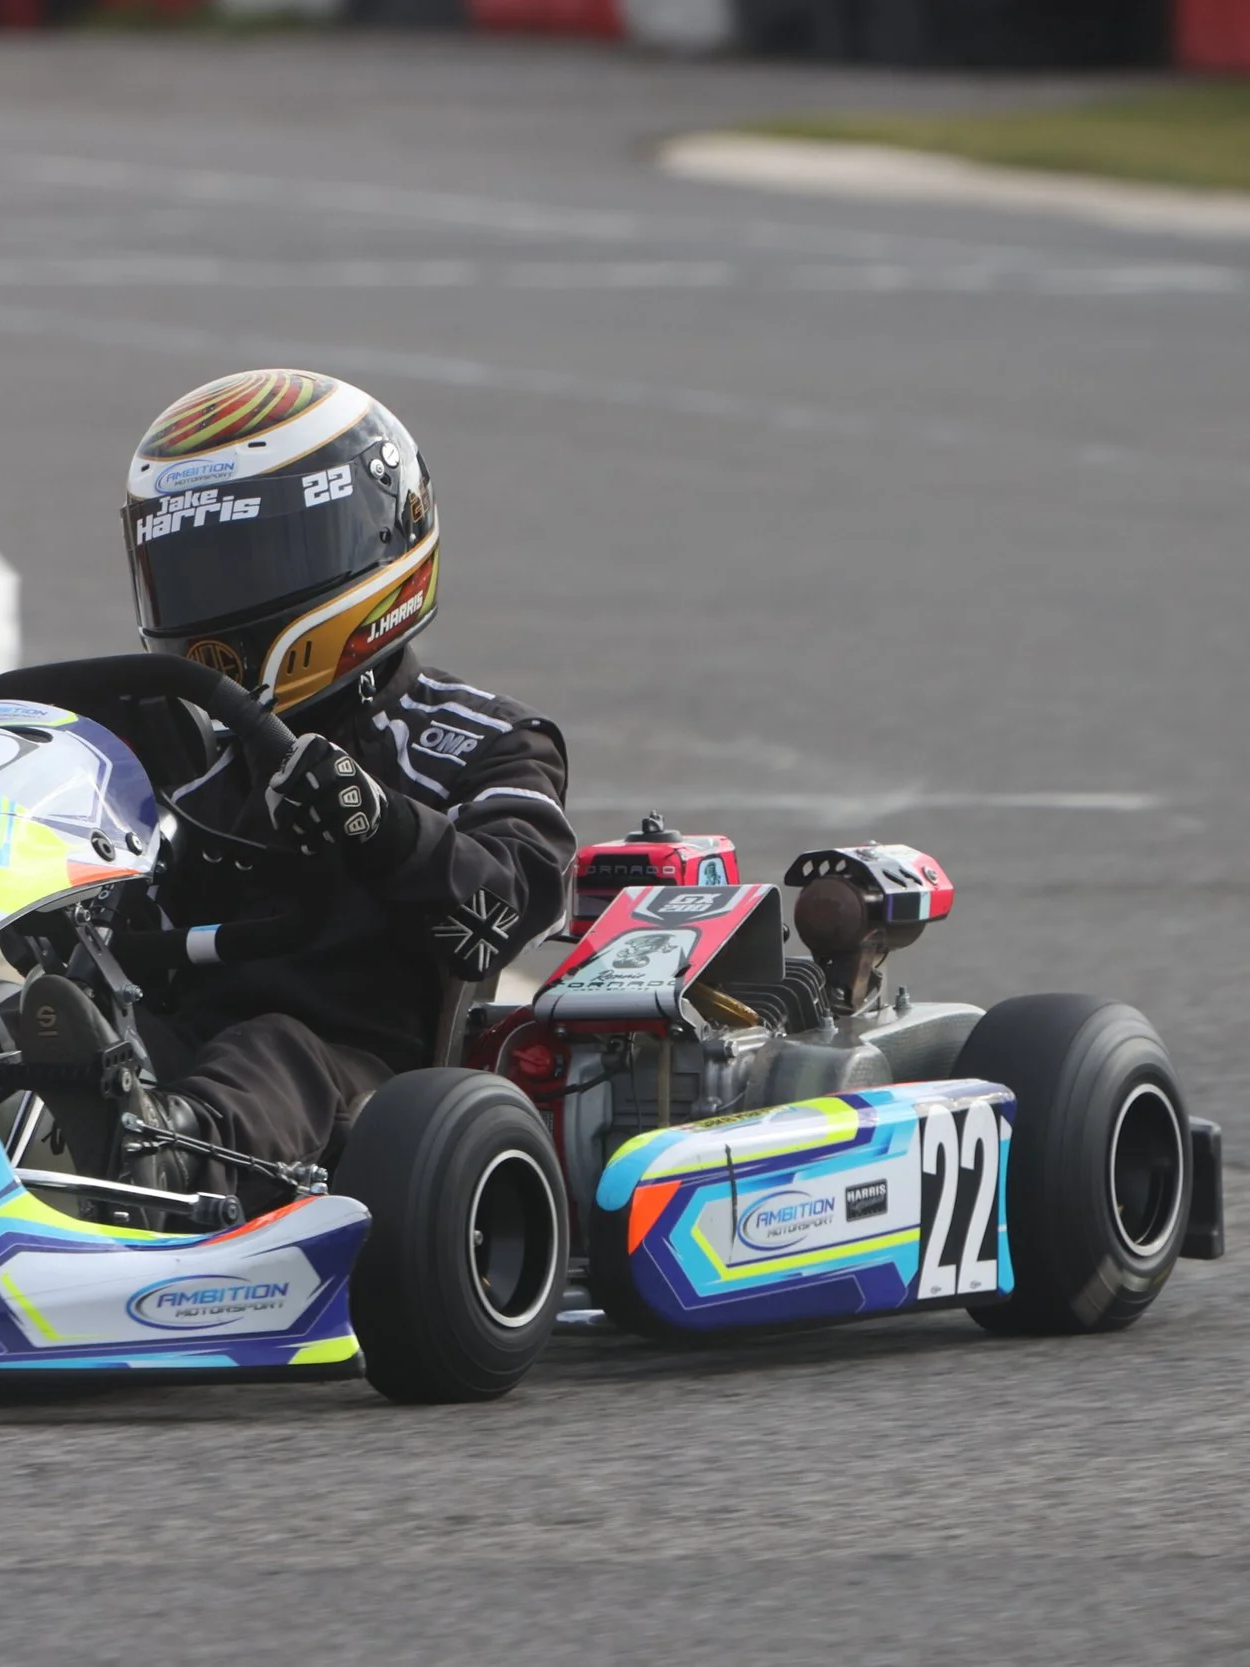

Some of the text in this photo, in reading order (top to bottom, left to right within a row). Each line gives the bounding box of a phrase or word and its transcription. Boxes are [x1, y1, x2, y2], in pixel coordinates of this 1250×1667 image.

[166, 462, 235, 482] AMBITION
[302, 464, 353, 507] 22
[156, 489, 218, 517] Jake
[137, 496, 261, 546] Harris
[367, 590, 423, 643] J.HARRIS
[420, 727, 478, 756] OMP
[657, 904, 713, 913] 200
[669, 893, 723, 904] GX
[847, 1184, 886, 1202] HARRIS
[917, 1100, 999, 1300] 22
[756, 1197, 836, 1229] AMBITION
[767, 1215, 833, 1238] MOTORSPORT
[156, 1282, 290, 1308] AMBITION
[175, 1301, 285, 1318] MOTORSPORT
